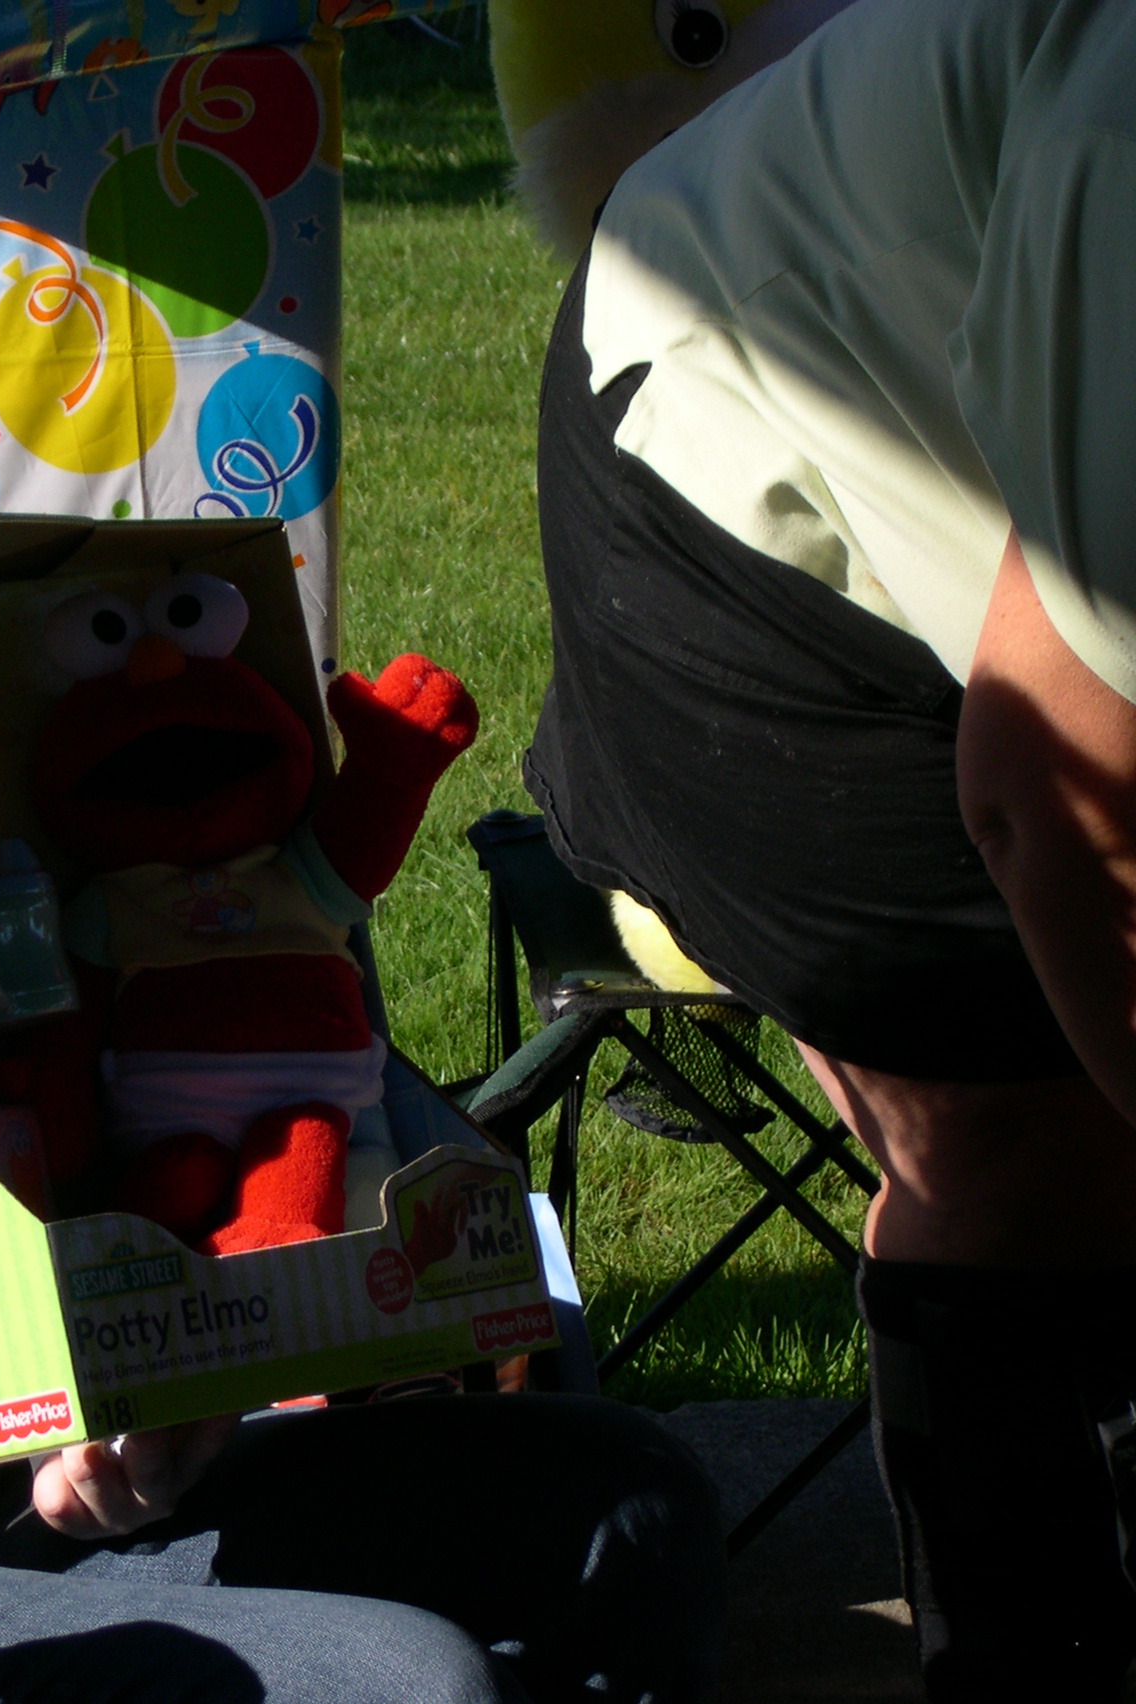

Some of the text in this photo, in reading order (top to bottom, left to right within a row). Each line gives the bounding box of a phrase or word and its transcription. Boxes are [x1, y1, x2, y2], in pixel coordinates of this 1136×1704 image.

[459, 1182, 510, 1222] Try
[467, 1218, 525, 1262] Me!
[71, 1256, 183, 1299] SESAME STREET
[420, 1275, 465, 1296] Squeeze
[465, 1265, 500, 1285] Elmo's
[74, 1290, 269, 1355] Potty Elmo
[83, 1334, 275, 1384] Help Elmo learn to use the potty!
